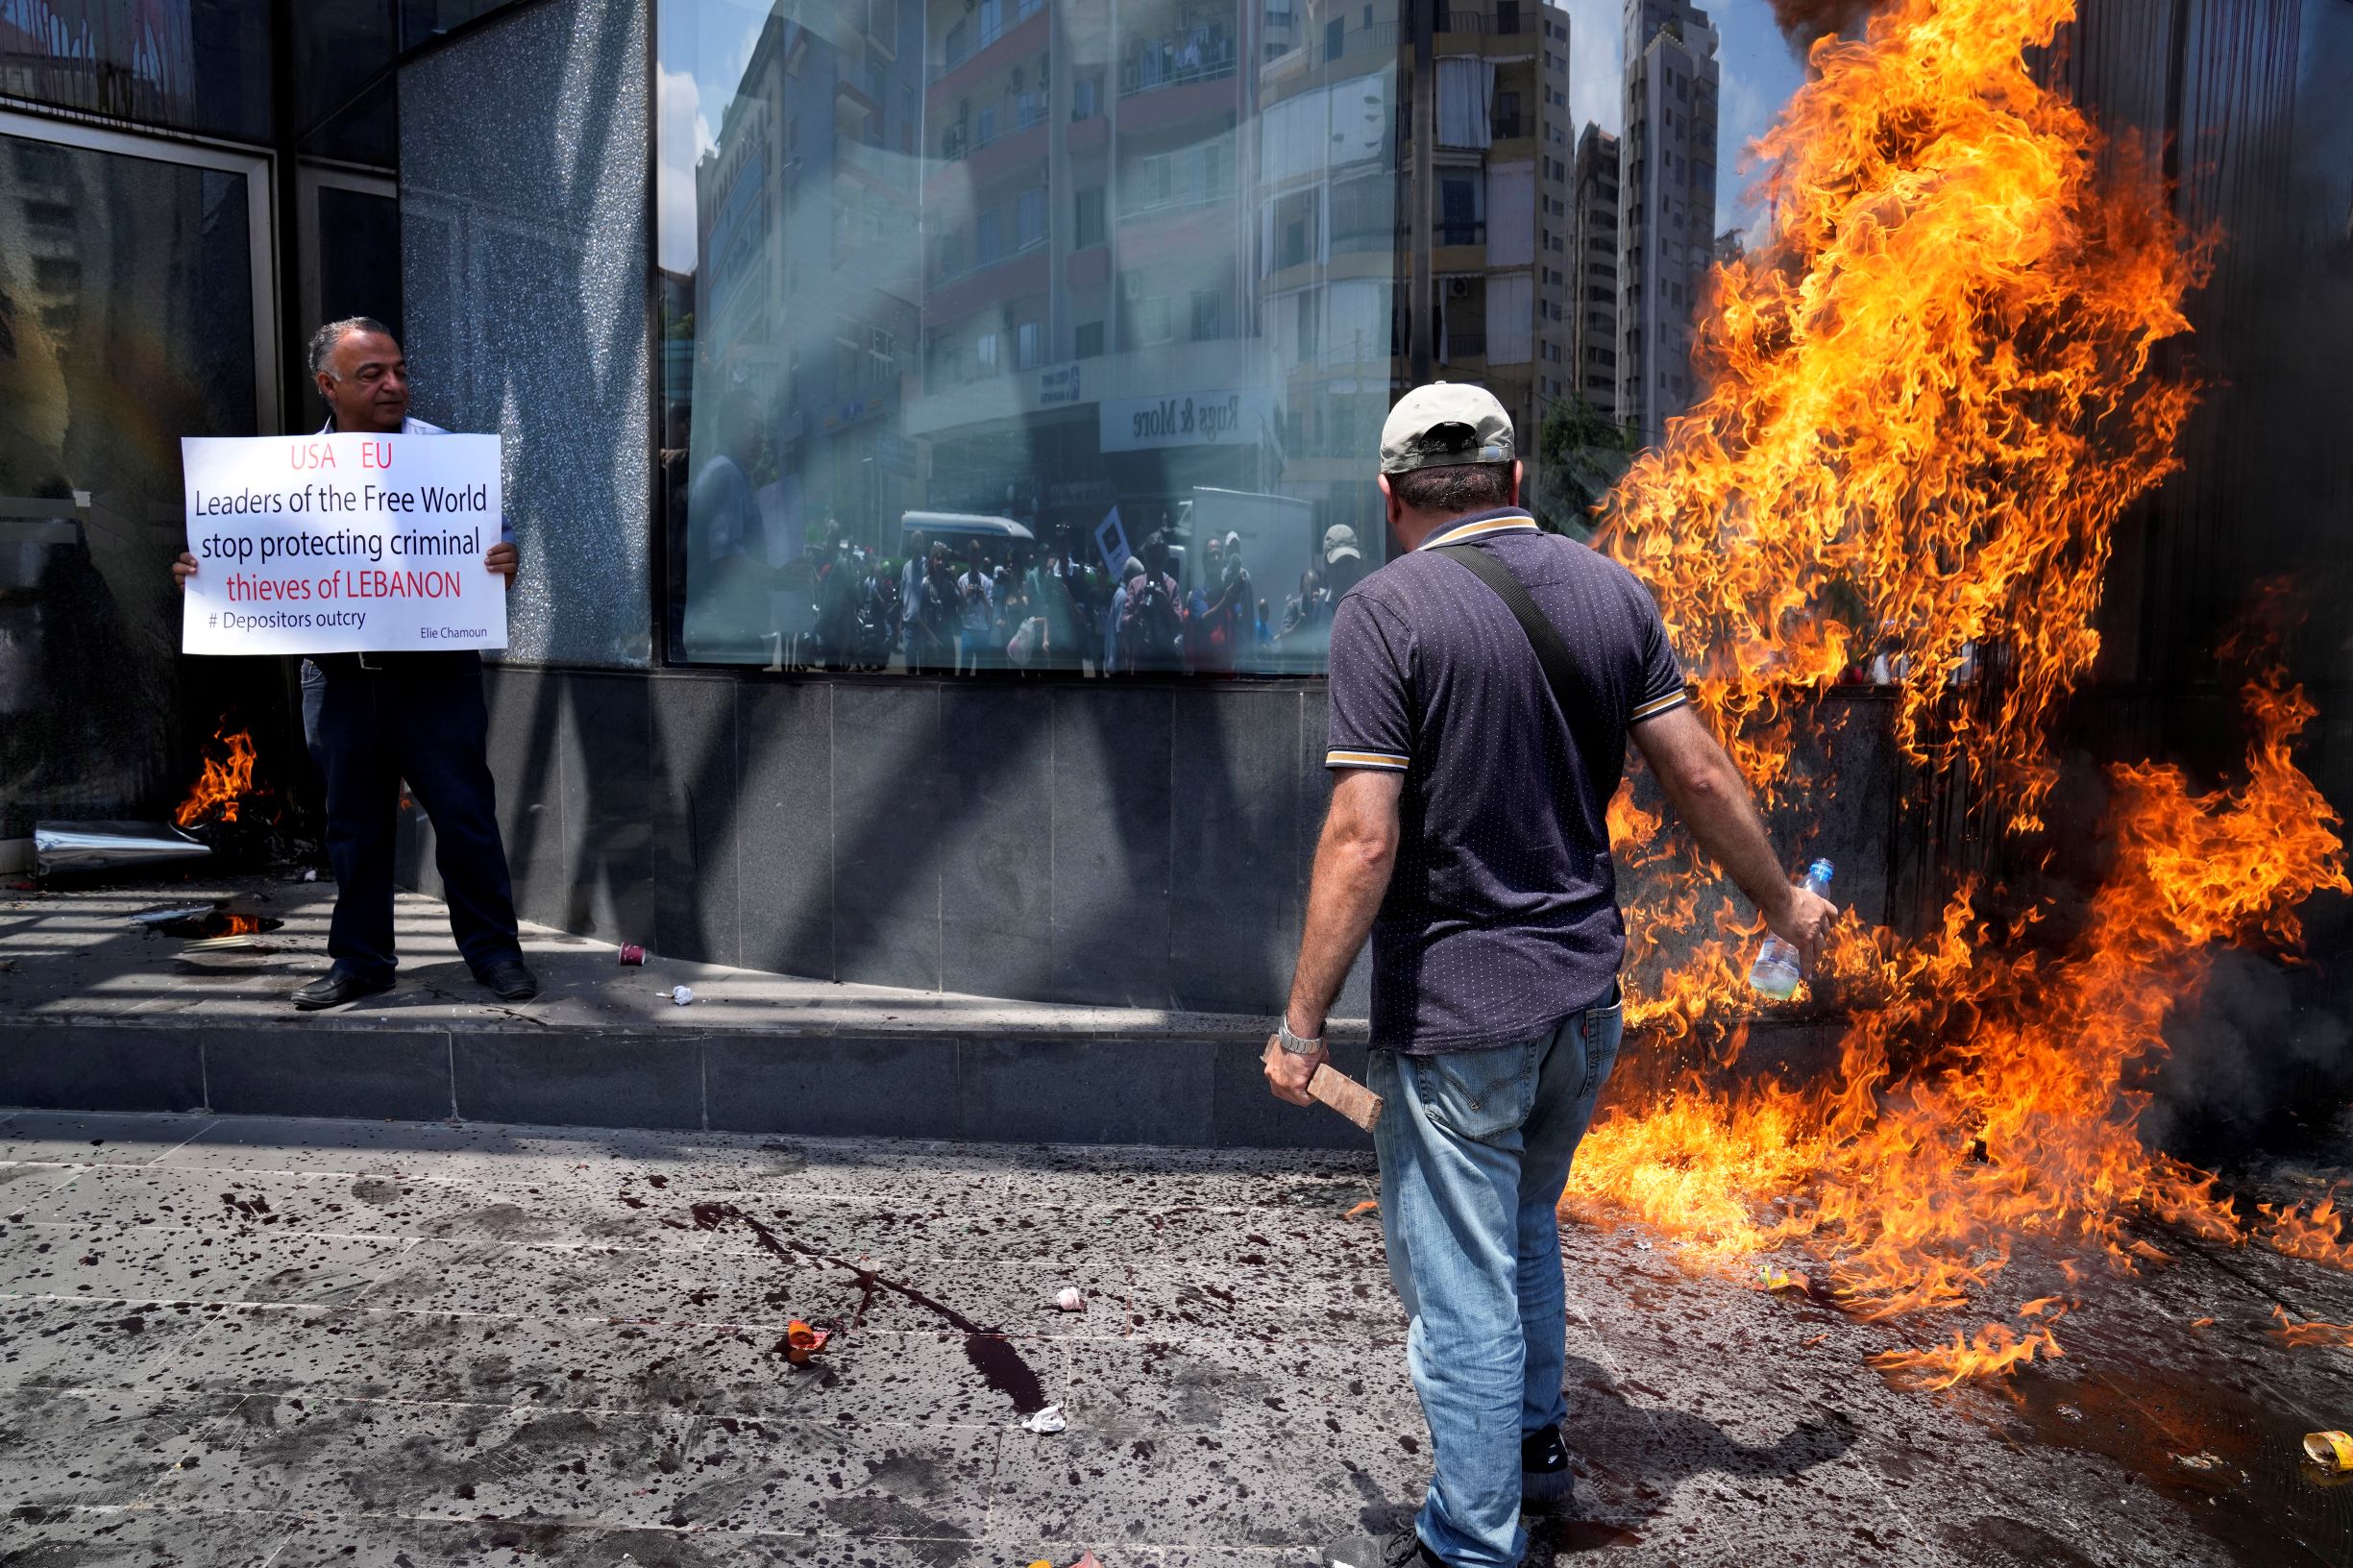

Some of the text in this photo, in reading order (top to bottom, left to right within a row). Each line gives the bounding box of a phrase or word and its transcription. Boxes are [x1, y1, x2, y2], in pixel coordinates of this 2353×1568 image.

[291, 442, 392, 470] USA EU
[195, 483, 487, 517] Leaders of the Free World
[202, 526, 479, 565] stop protecting criminal
[226, 570, 461, 601] thieves of LEBANON
[223, 611, 312, 633] Depositors
[315, 611, 366, 630] outcry
[420, 626, 488, 639] Elie Chamoun
